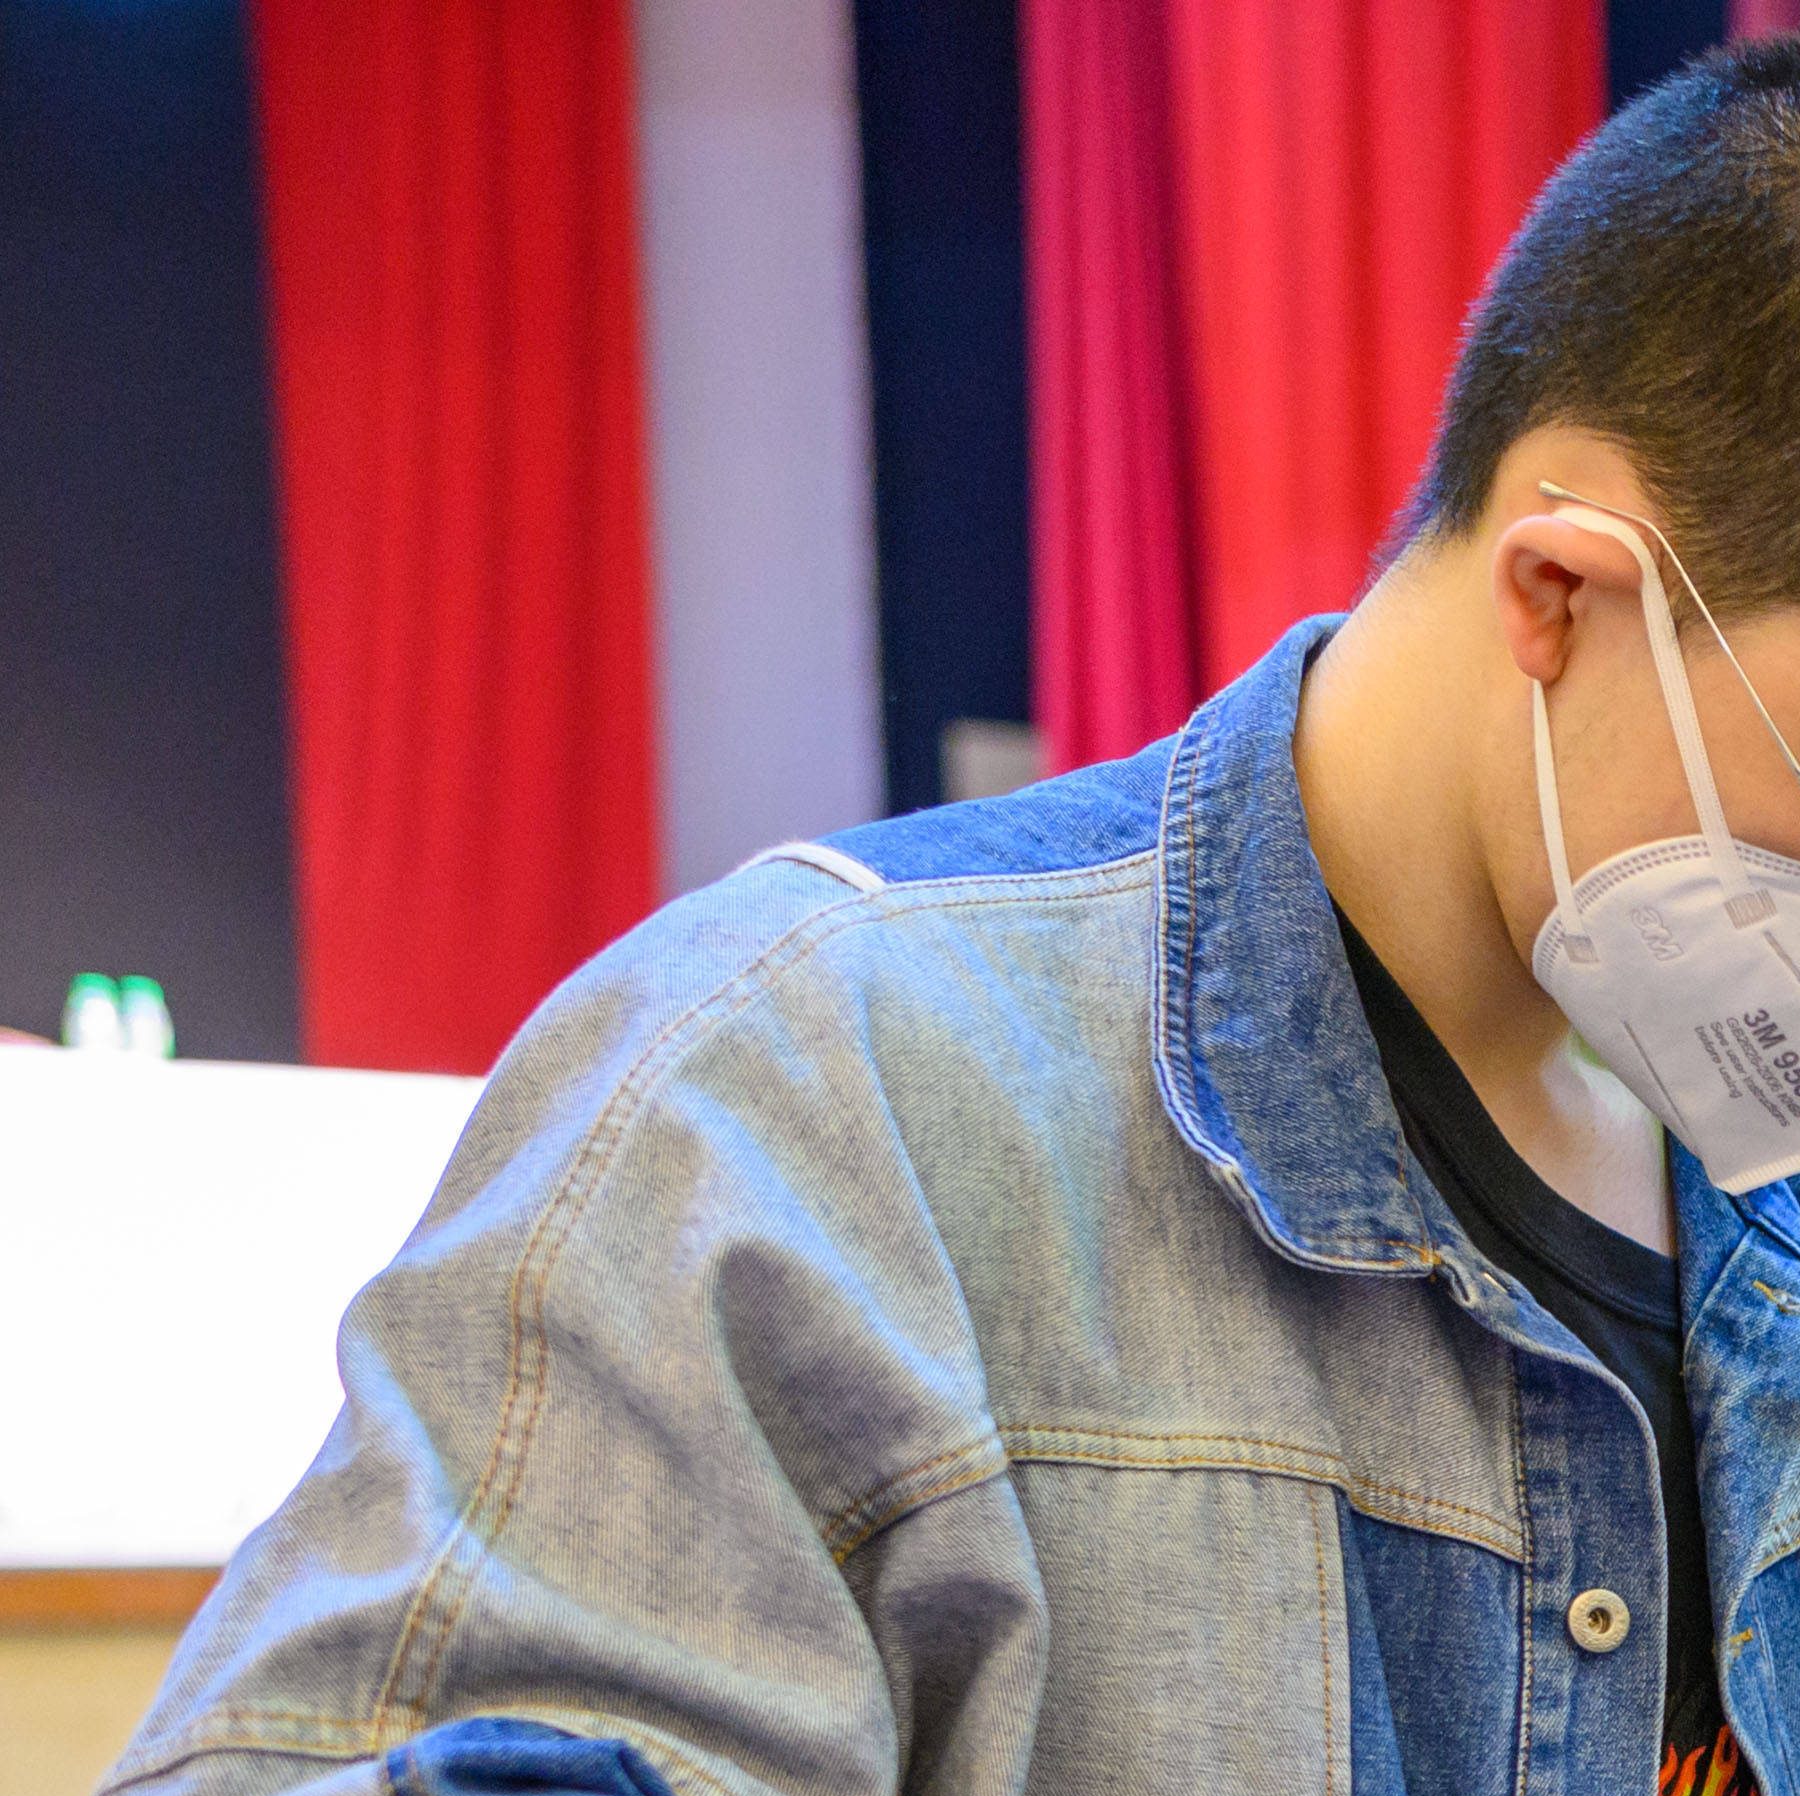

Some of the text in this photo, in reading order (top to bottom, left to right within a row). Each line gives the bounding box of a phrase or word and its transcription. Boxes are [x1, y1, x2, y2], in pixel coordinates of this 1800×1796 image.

[1629, 905, 1685, 961] 3M
[1710, 1021, 1729, 1046] See
[1727, 1050, 1746, 1074] user
[1743, 1009, 1787, 1050] 3M
[1694, 1026, 1743, 1098] before using
